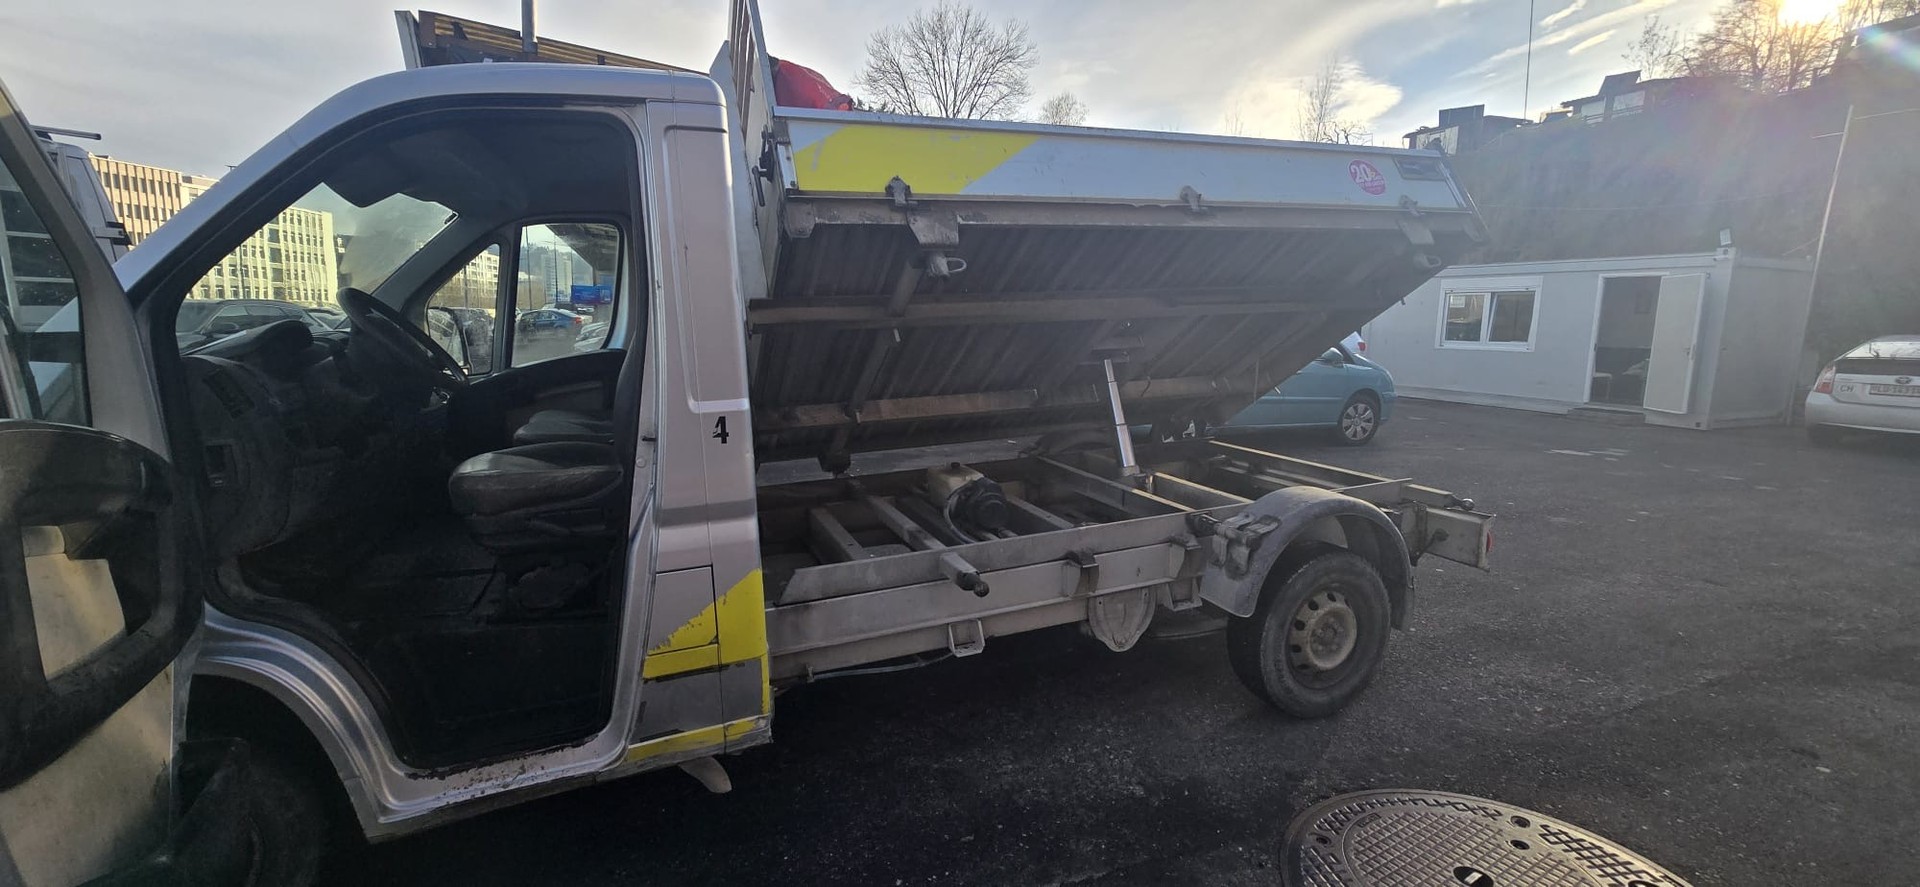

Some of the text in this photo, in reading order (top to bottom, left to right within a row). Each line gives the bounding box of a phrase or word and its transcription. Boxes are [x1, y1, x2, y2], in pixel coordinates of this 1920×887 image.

[1350, 164, 1371, 183] 20
[1840, 384, 1855, 392] CH
[712, 415, 729, 444] 4
